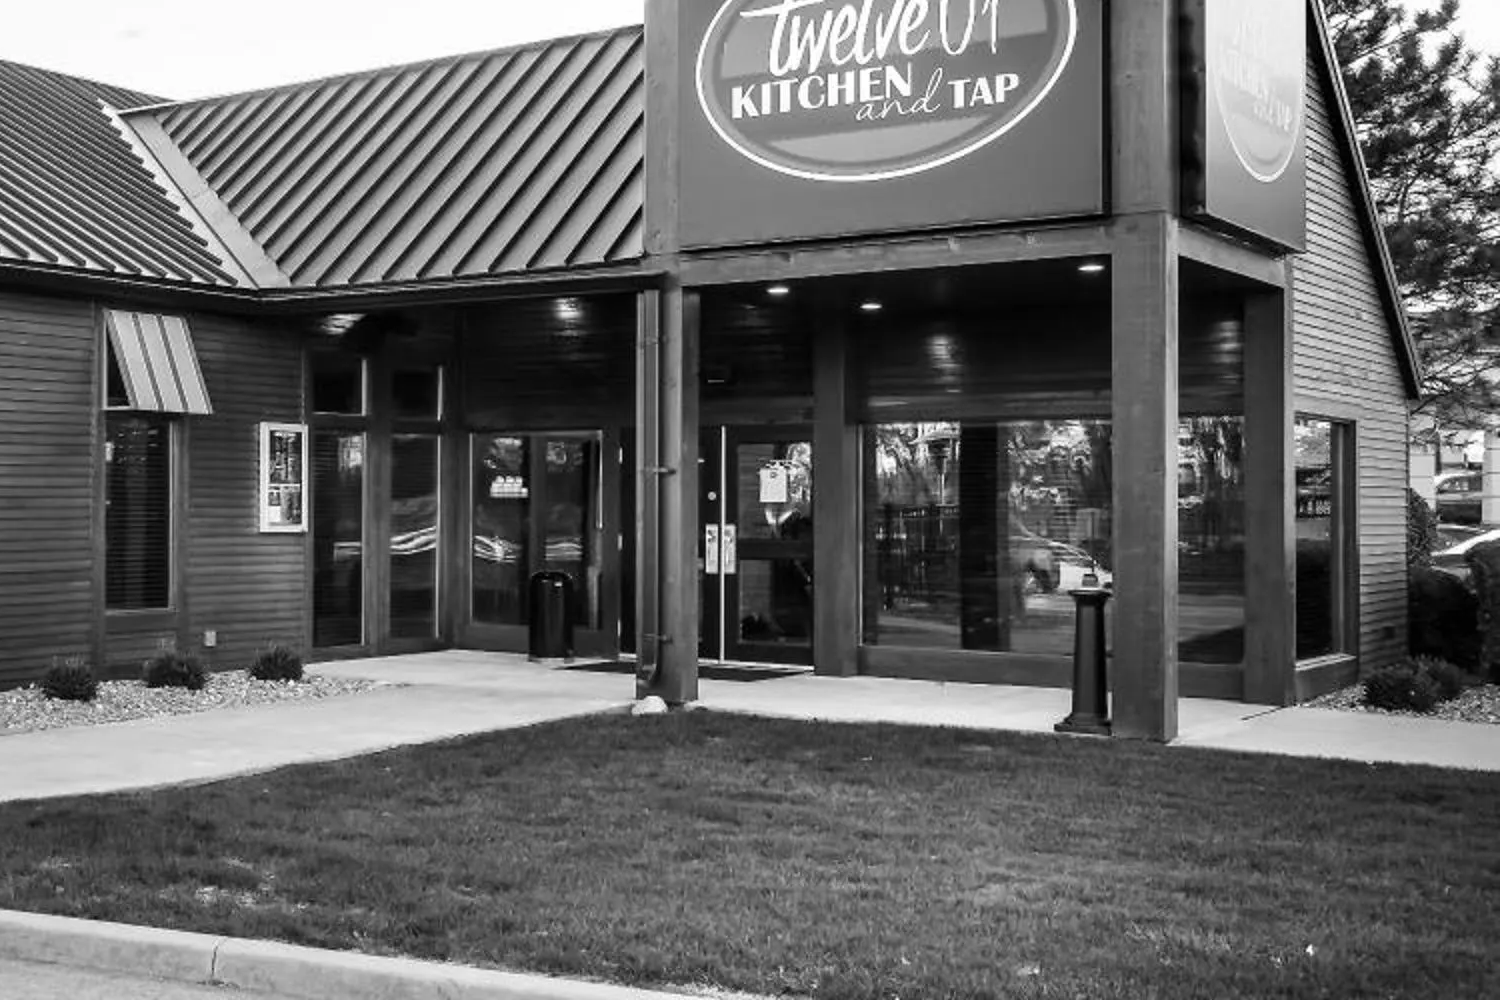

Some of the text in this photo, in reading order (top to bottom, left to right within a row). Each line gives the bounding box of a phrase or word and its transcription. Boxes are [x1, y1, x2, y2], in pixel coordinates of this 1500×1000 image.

[731, 62, 1020, 121] KITCHEN and TAP
